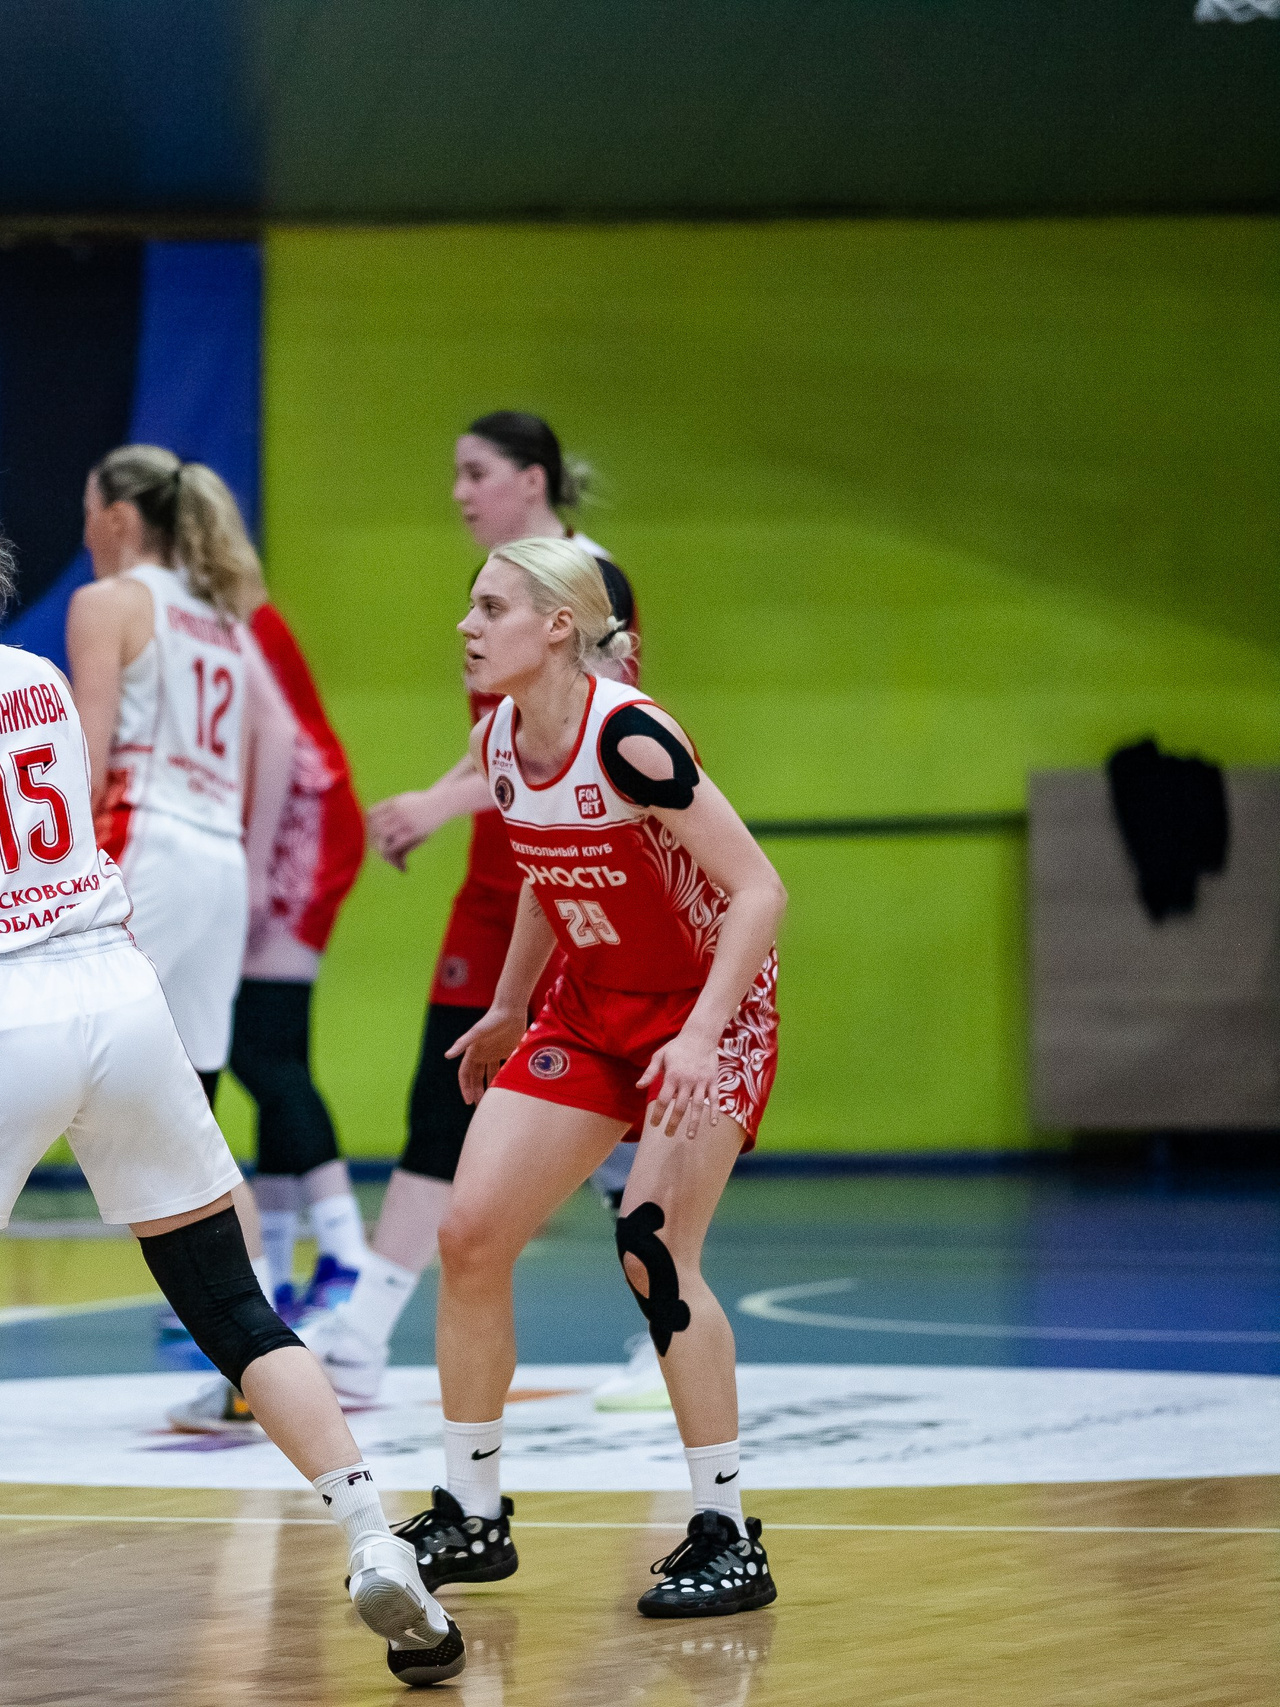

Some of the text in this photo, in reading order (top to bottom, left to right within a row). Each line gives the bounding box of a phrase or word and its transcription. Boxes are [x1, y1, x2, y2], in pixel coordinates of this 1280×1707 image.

[191, 656, 235, 760] 12
[581, 800, 601, 815] BET
[581, 843, 613, 857] КЛУБ
[554, 899, 621, 949] 25
